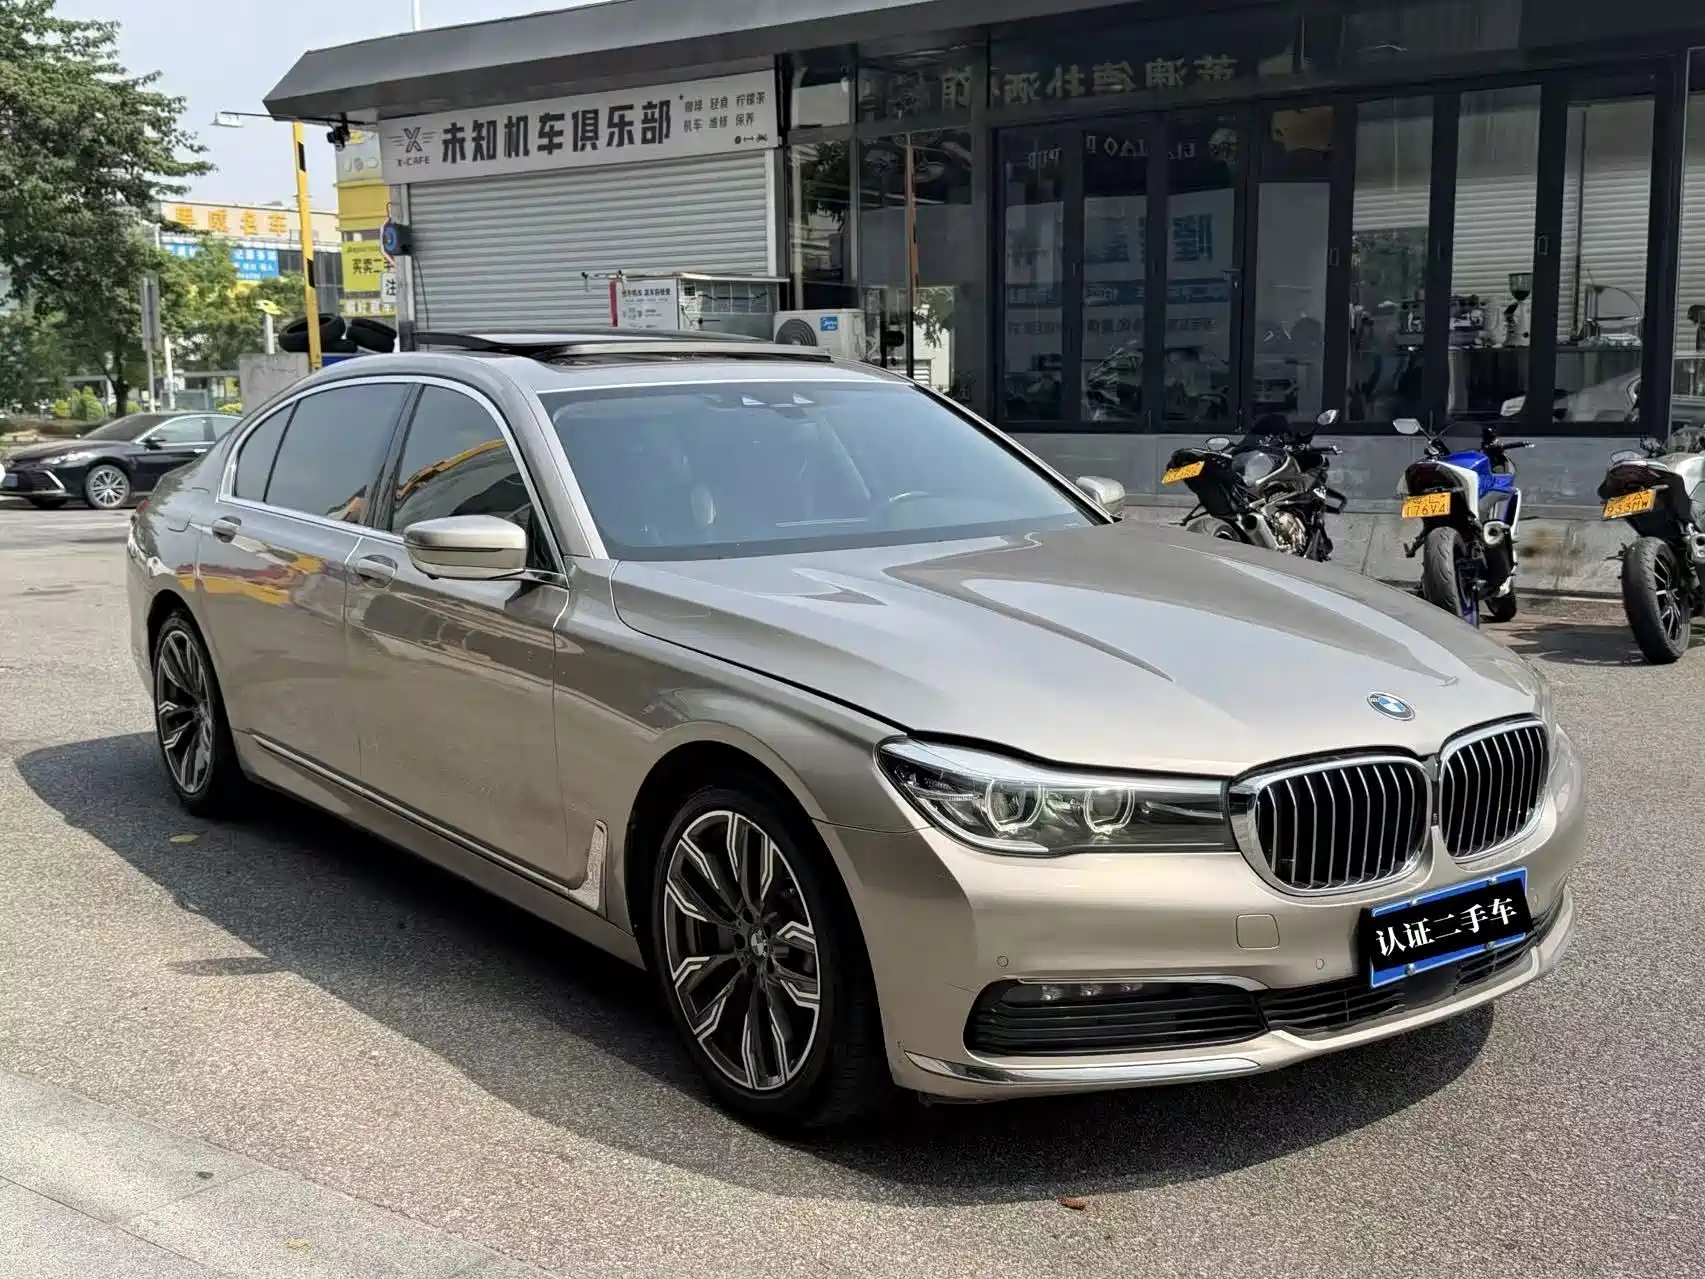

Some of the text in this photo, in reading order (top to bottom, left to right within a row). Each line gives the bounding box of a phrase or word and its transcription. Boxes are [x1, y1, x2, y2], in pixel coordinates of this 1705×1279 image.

[441, 100, 672, 164] 未知机车俱乐部
